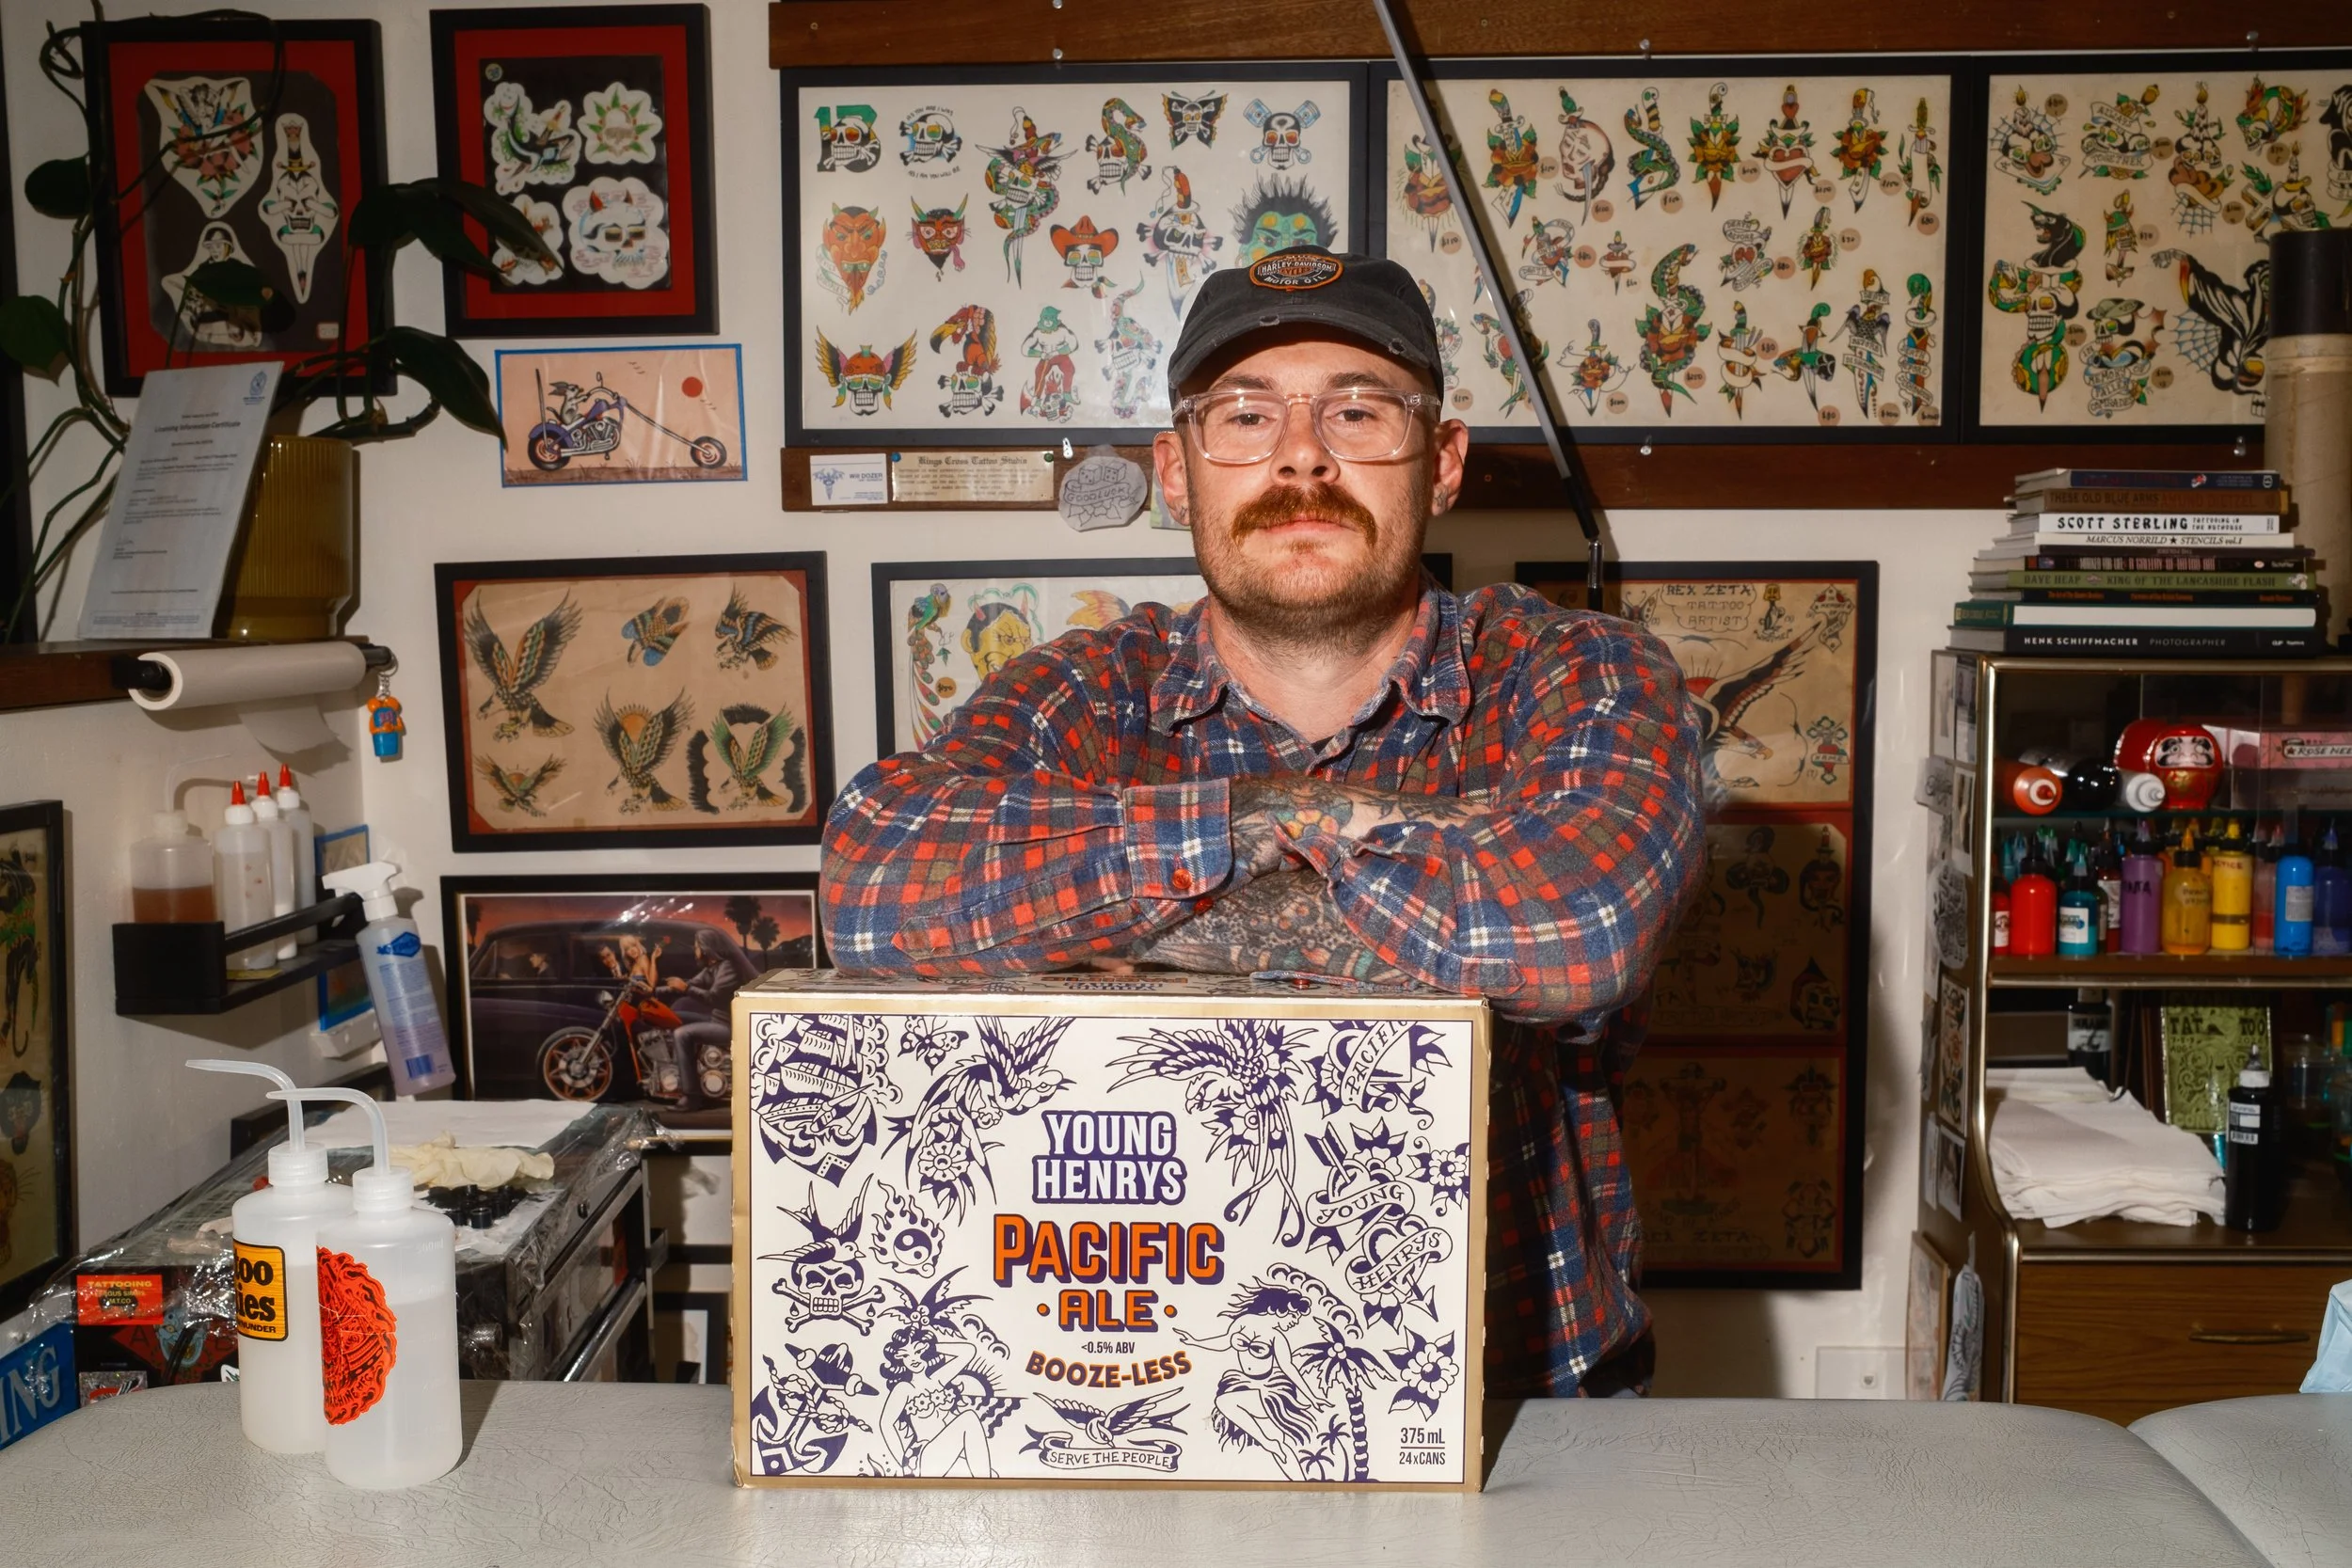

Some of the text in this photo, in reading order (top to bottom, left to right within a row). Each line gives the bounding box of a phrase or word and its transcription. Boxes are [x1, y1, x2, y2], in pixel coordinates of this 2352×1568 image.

[2092, 154, 2145, 167] TOGETHER
[1264, 275, 1327, 285] MOTOR OIL
[917, 455, 1028, 467] Kings Cross Tattoo Studio
[2049, 492, 2081, 503] THESE
[2083, 492, 2103, 503] OLD
[2104, 492, 2131, 503] BLUE
[2132, 492, 2160, 503] ARMS
[2058, 515, 2188, 530] SCOTT STERLING
[2086, 534, 2124, 545] MARCUS
[2125, 534, 2168, 545] NORRILD
[2180, 534, 2223, 546] STENCILS
[2024, 575, 2277, 587] DAVE HEAP KING OF THE LANCASHIRE FLASH
[1666, 584, 1752, 595] REX ZETA
[1686, 601, 1744, 610] TATTOO
[1688, 616, 1742, 626] ARTIST
[2024, 637, 2227, 647] HENK SCHIFFMACHER PHOTOGRAPHER
[2297, 746, 2328, 755] ROSE
[2169, 1016, 2203, 1036] TAT
[2238, 1016, 2266, 1036] TOO
[1043, 1112, 1175, 1157] YOUNG
[1034, 1158, 1185, 1203] HENRYS
[1317, 1183, 1405, 1224] YOUNG
[1692, 1230, 1751, 1243] ZETA
[993, 1214, 1225, 1288] PACIFIC
[1355, 1231, 1442, 1291] HENRYS
[1057, 1289, 1159, 1333] ALE
[1081, 1341, 1136, 1354] <0.5% ABV
[1025, 1350, 1193, 1388] BOOZE-LESS
[1400, 1427, 1446, 1444] 375 mL
[1049, 1451, 1171, 1468] SERVE THE PEOPLE
[1399, 1451, 1446, 1465] 24xCANS
